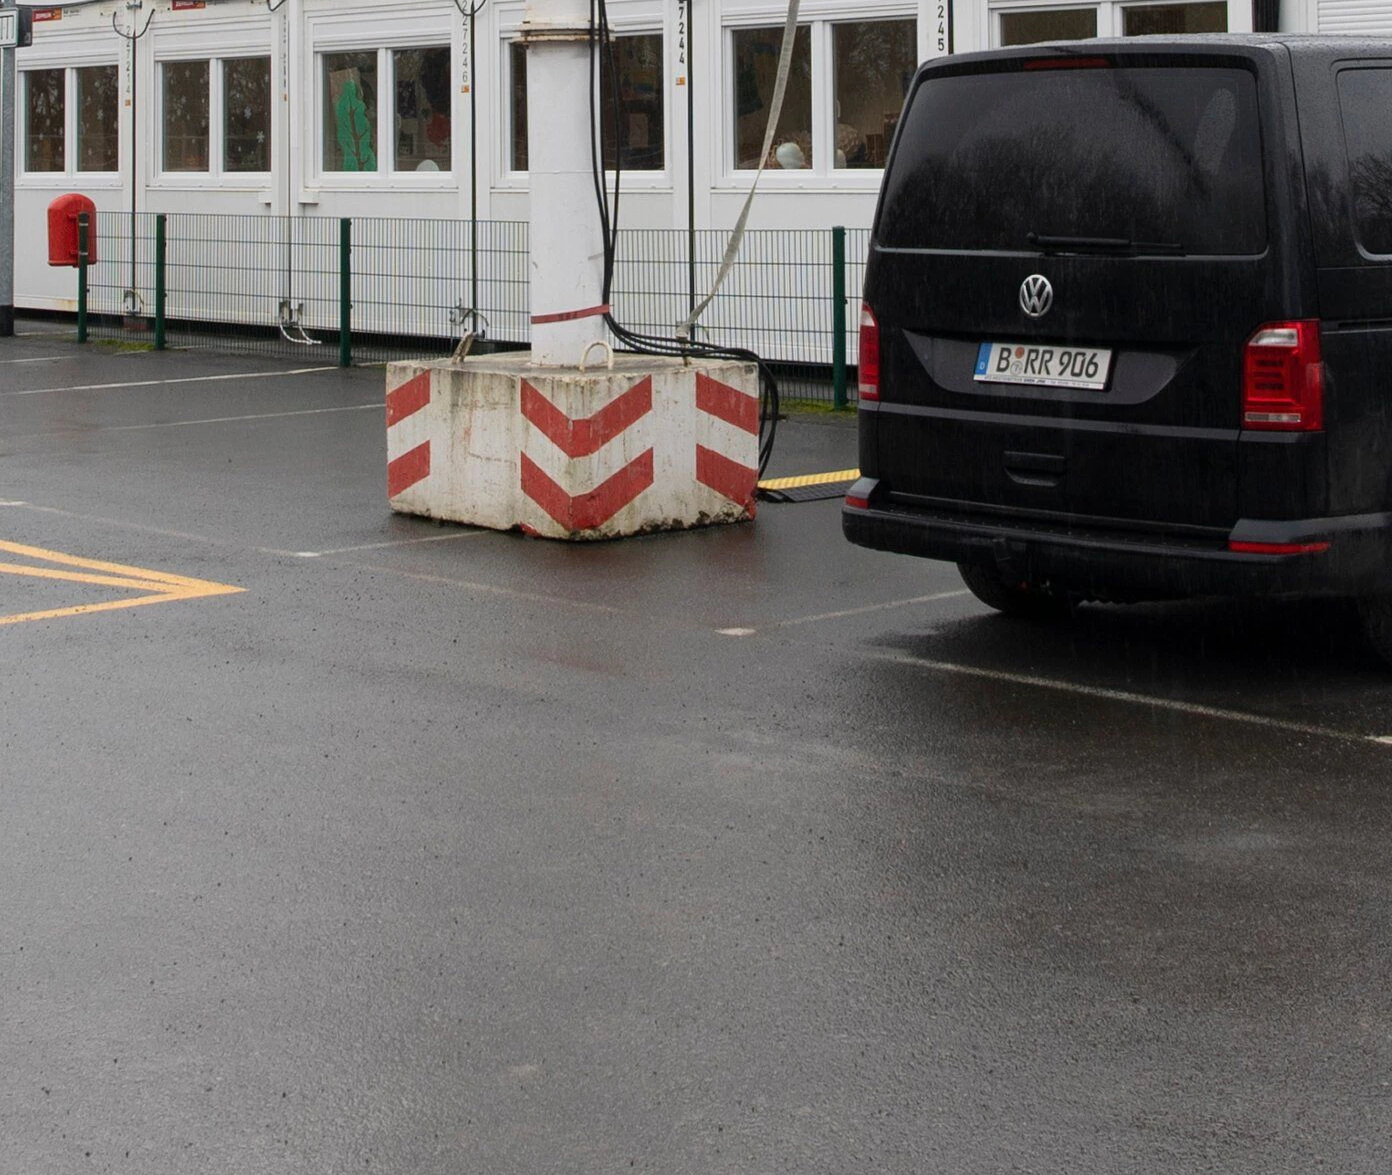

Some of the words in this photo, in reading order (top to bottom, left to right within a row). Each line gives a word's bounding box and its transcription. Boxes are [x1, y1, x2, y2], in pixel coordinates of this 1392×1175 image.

[996, 347, 1012, 372] B
[1024, 349, 1054, 375] RR
[1058, 351, 1099, 378] 906
